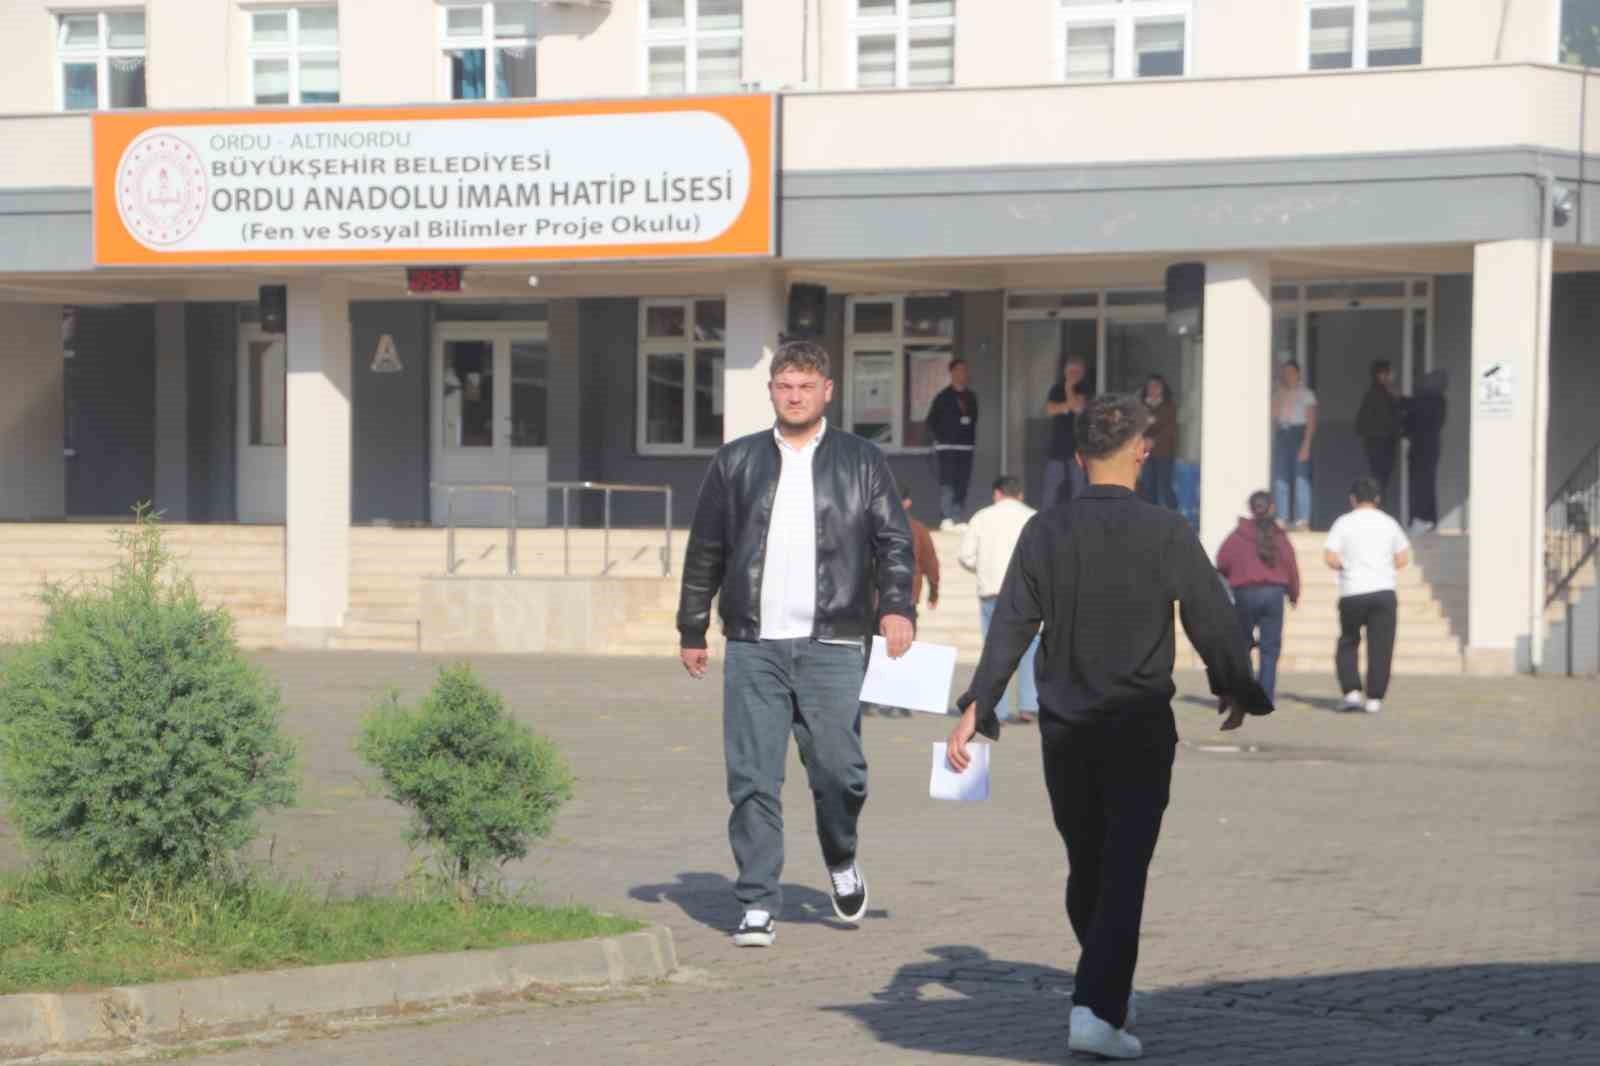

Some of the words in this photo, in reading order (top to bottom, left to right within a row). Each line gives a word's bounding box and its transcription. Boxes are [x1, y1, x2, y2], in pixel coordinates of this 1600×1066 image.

[209, 133, 271, 151] ORDU
[290, 131, 412, 150] ALTINORDU
[211, 154, 386, 180] BÜYÜKŞEHİR
[394, 150, 551, 174] BELEDİYESİ
[211, 187, 295, 212] ORDU
[303, 184, 448, 212] ANADOLU
[457, 178, 541, 209] İMAM
[550, 173, 636, 206] HATİP
[644, 169, 732, 203] LİSESİ
[241, 222, 294, 242] (Fen
[303, 226, 331, 240] ve
[338, 220, 419, 242] Sosyal
[428, 218, 527, 238] Bilimler
[536, 216, 603, 239] Proje
[611, 213, 700, 234] Okulu)
[370, 333, 403, 373] A
